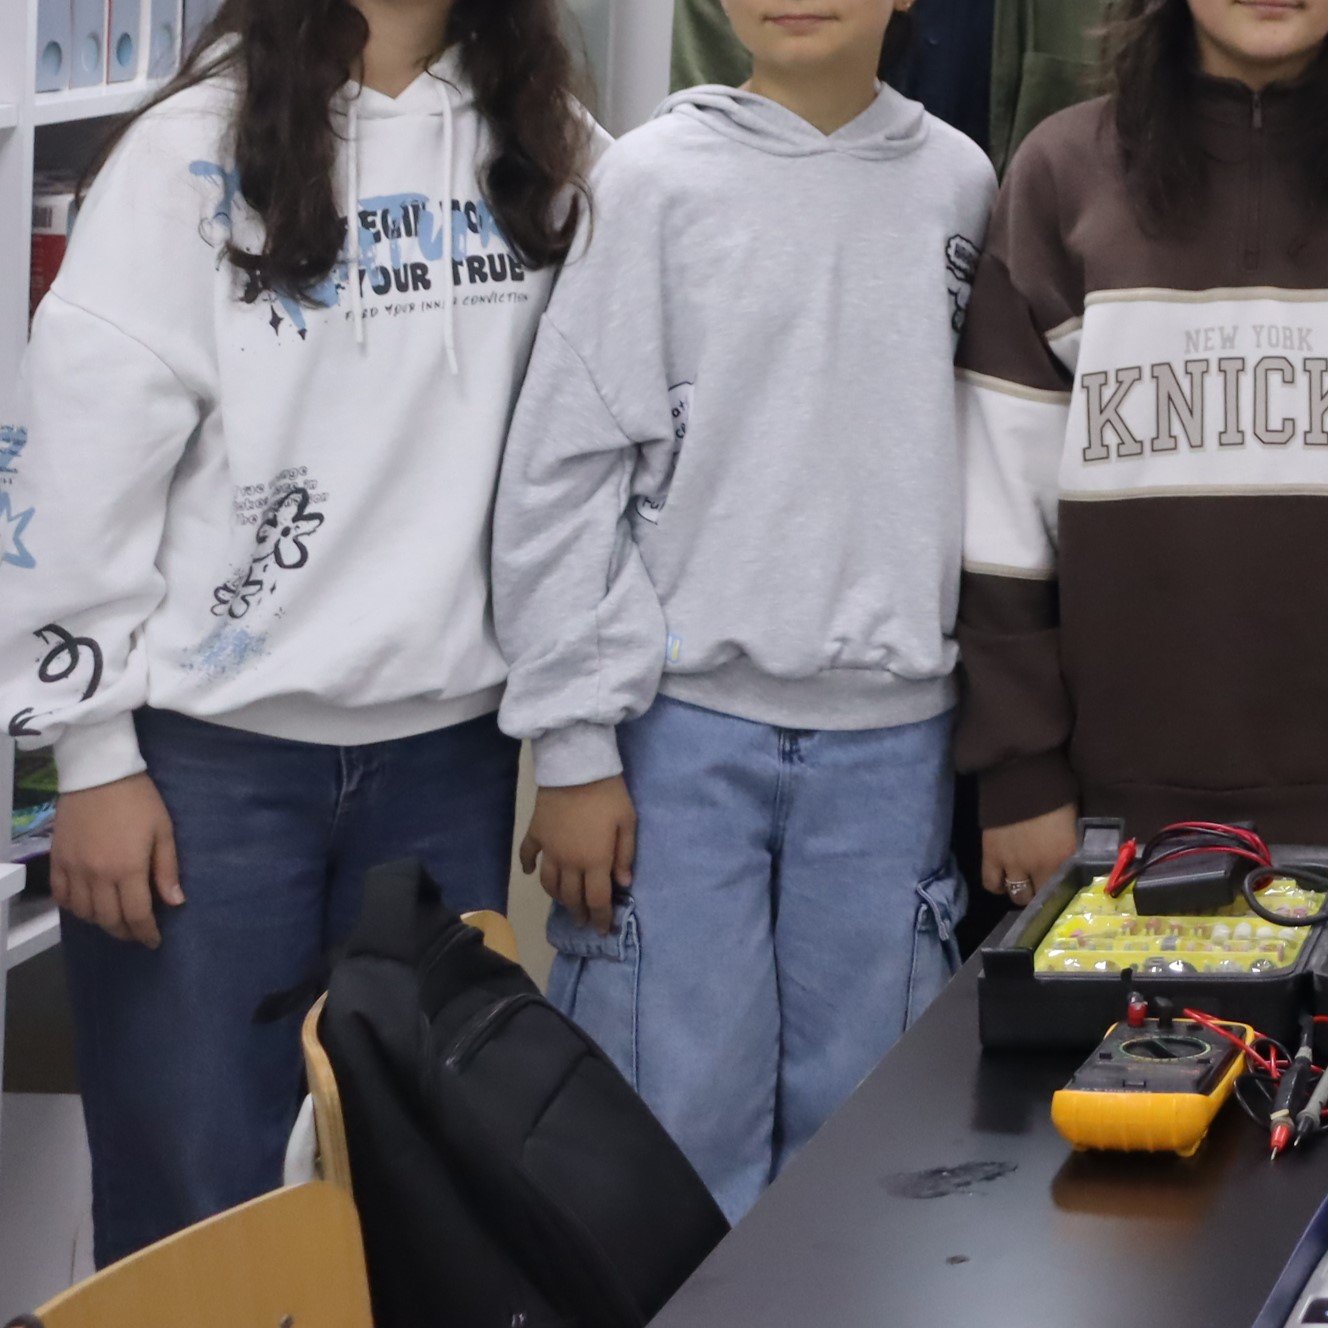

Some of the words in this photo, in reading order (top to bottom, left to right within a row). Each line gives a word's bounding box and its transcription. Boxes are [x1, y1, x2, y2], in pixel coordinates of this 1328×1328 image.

[462, 290, 529, 307] CONVICTION
[1184, 325, 1240, 354] NEW
[1252, 324, 1314, 352] YORK
